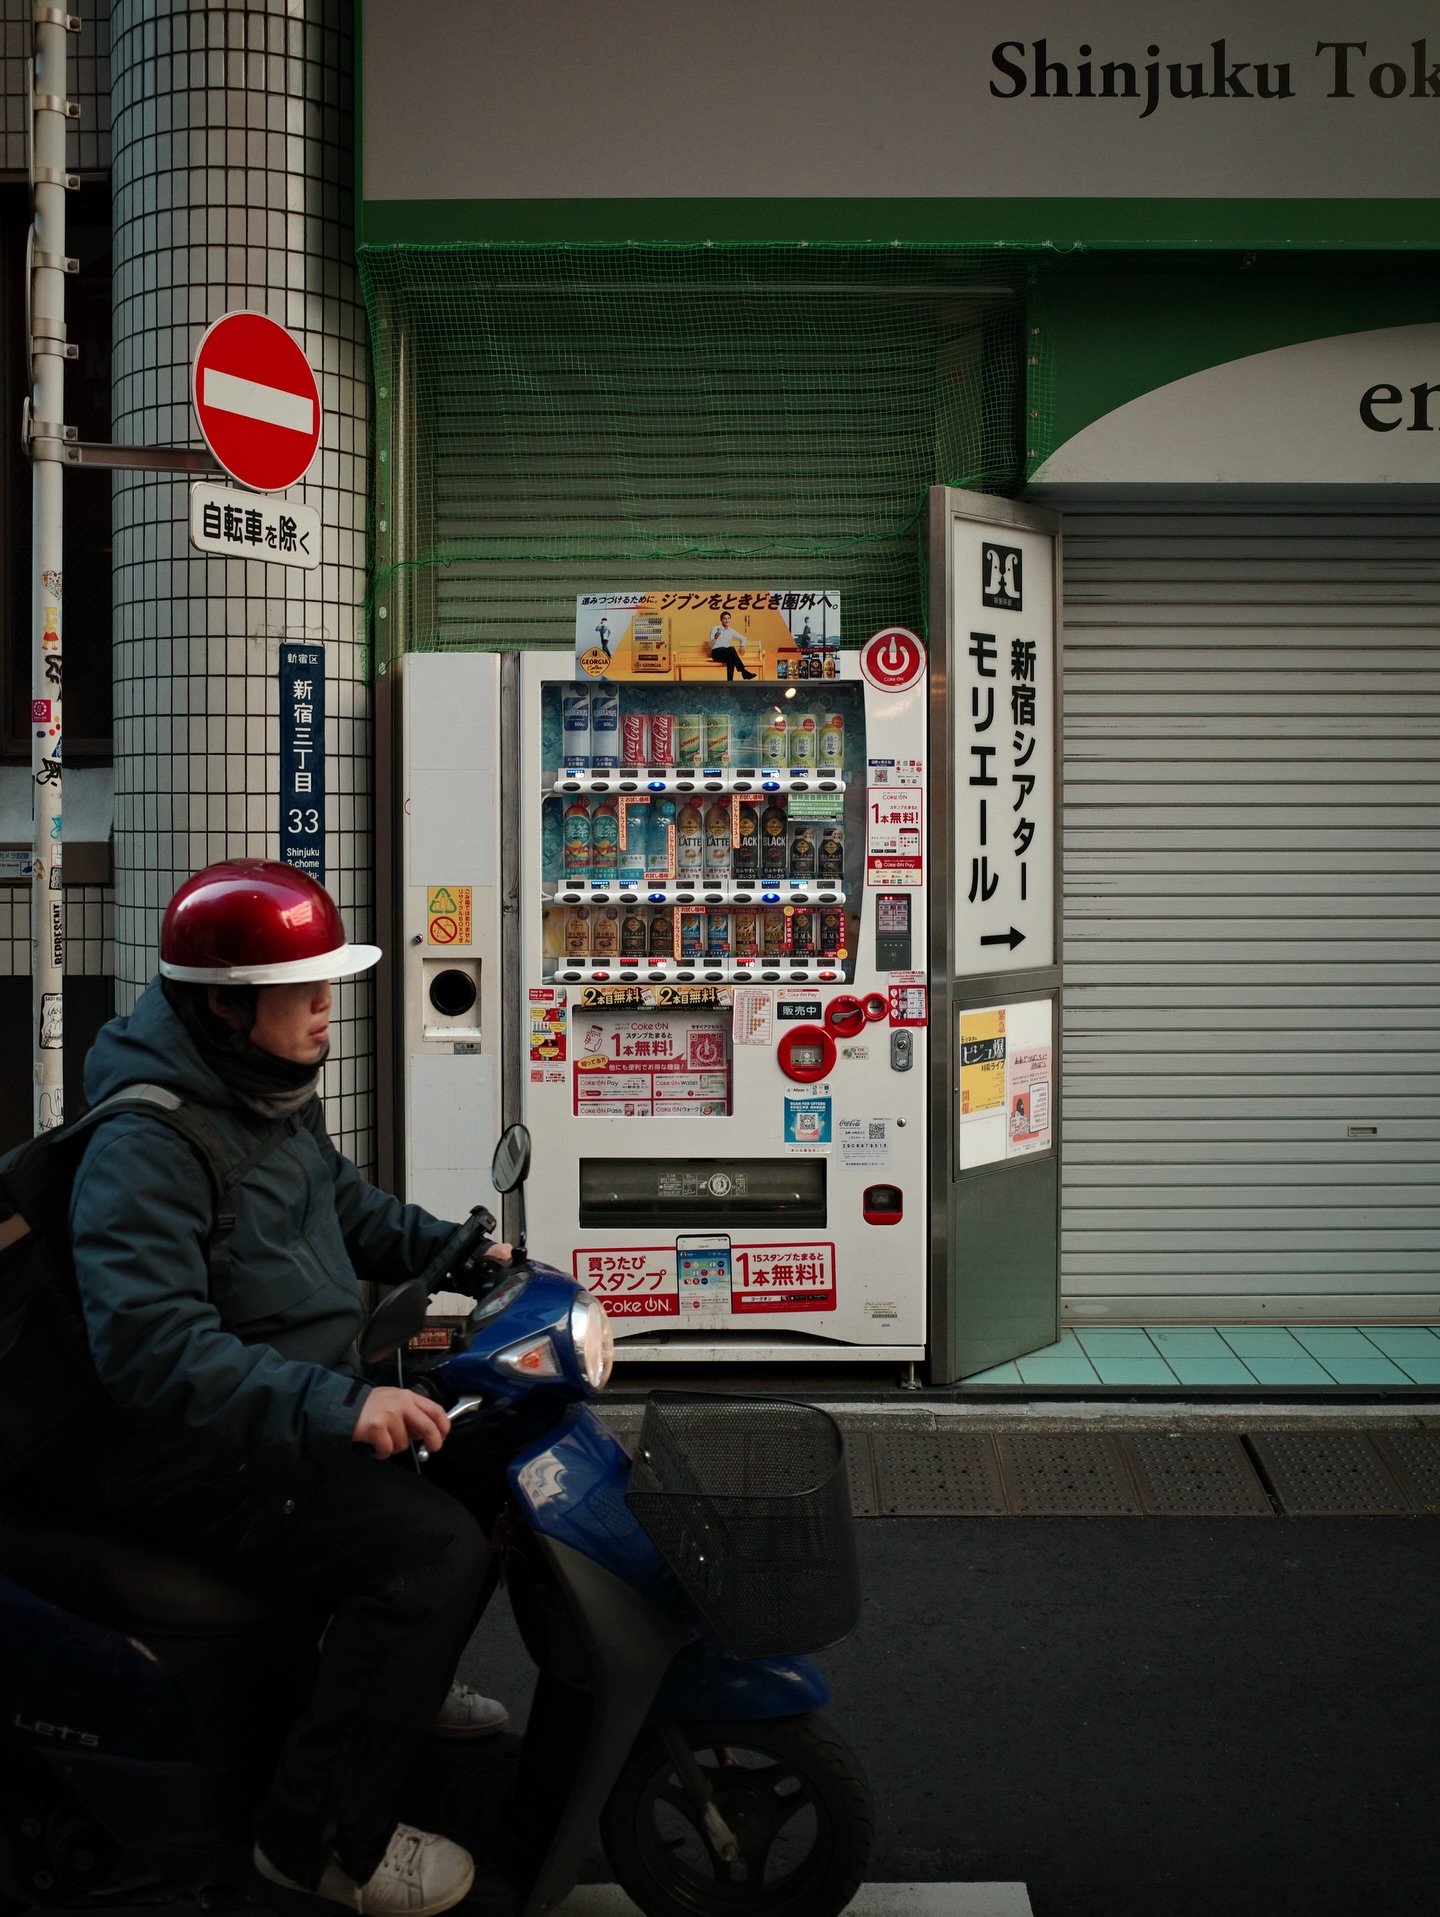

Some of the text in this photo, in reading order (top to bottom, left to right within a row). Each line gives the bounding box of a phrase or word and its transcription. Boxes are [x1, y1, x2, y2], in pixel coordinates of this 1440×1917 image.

[989, 38, 1440, 119] Shinjuku Tok
[203, 501, 310, 555] 自転車を除く
[581, 595, 658, 606] 進みつづけるために。
[660, 592, 839, 611] ジブンをときどき圏外へ。
[287, 653, 319, 665] 新宿区
[292, 679, 313, 793] 新宿三丁目
[968, 632, 999, 903] モリエール
[1010, 638, 1036, 900] 新宿シアター
[288, 808, 319, 834] 33
[871, 803, 919, 824] 1本無料!
[678, 838, 702, 847] LATTE
[707, 838, 730, 847] LATTE
[740, 837, 758, 846] LACK
[763, 837, 786, 846] BLACK
[286, 847, 320, 858] Shinjuku
[584, 987, 640, 1006] 2本目無料
[660, 987, 716, 1006] 2本目無料
[782, 1006, 817, 1016] 販売中
[631, 1021, 669, 1030] Coke ON
[611, 1032, 674, 1057] 1本無料!
[588, 1255, 646, 1272] 買うたび
[752, 1252, 825, 1263] 15スタンプたまると
[735, 1252, 825, 1287] 1本無料!
[588, 1269, 666, 1292] スタンプ
[602, 1300, 641, 1313] Coke
